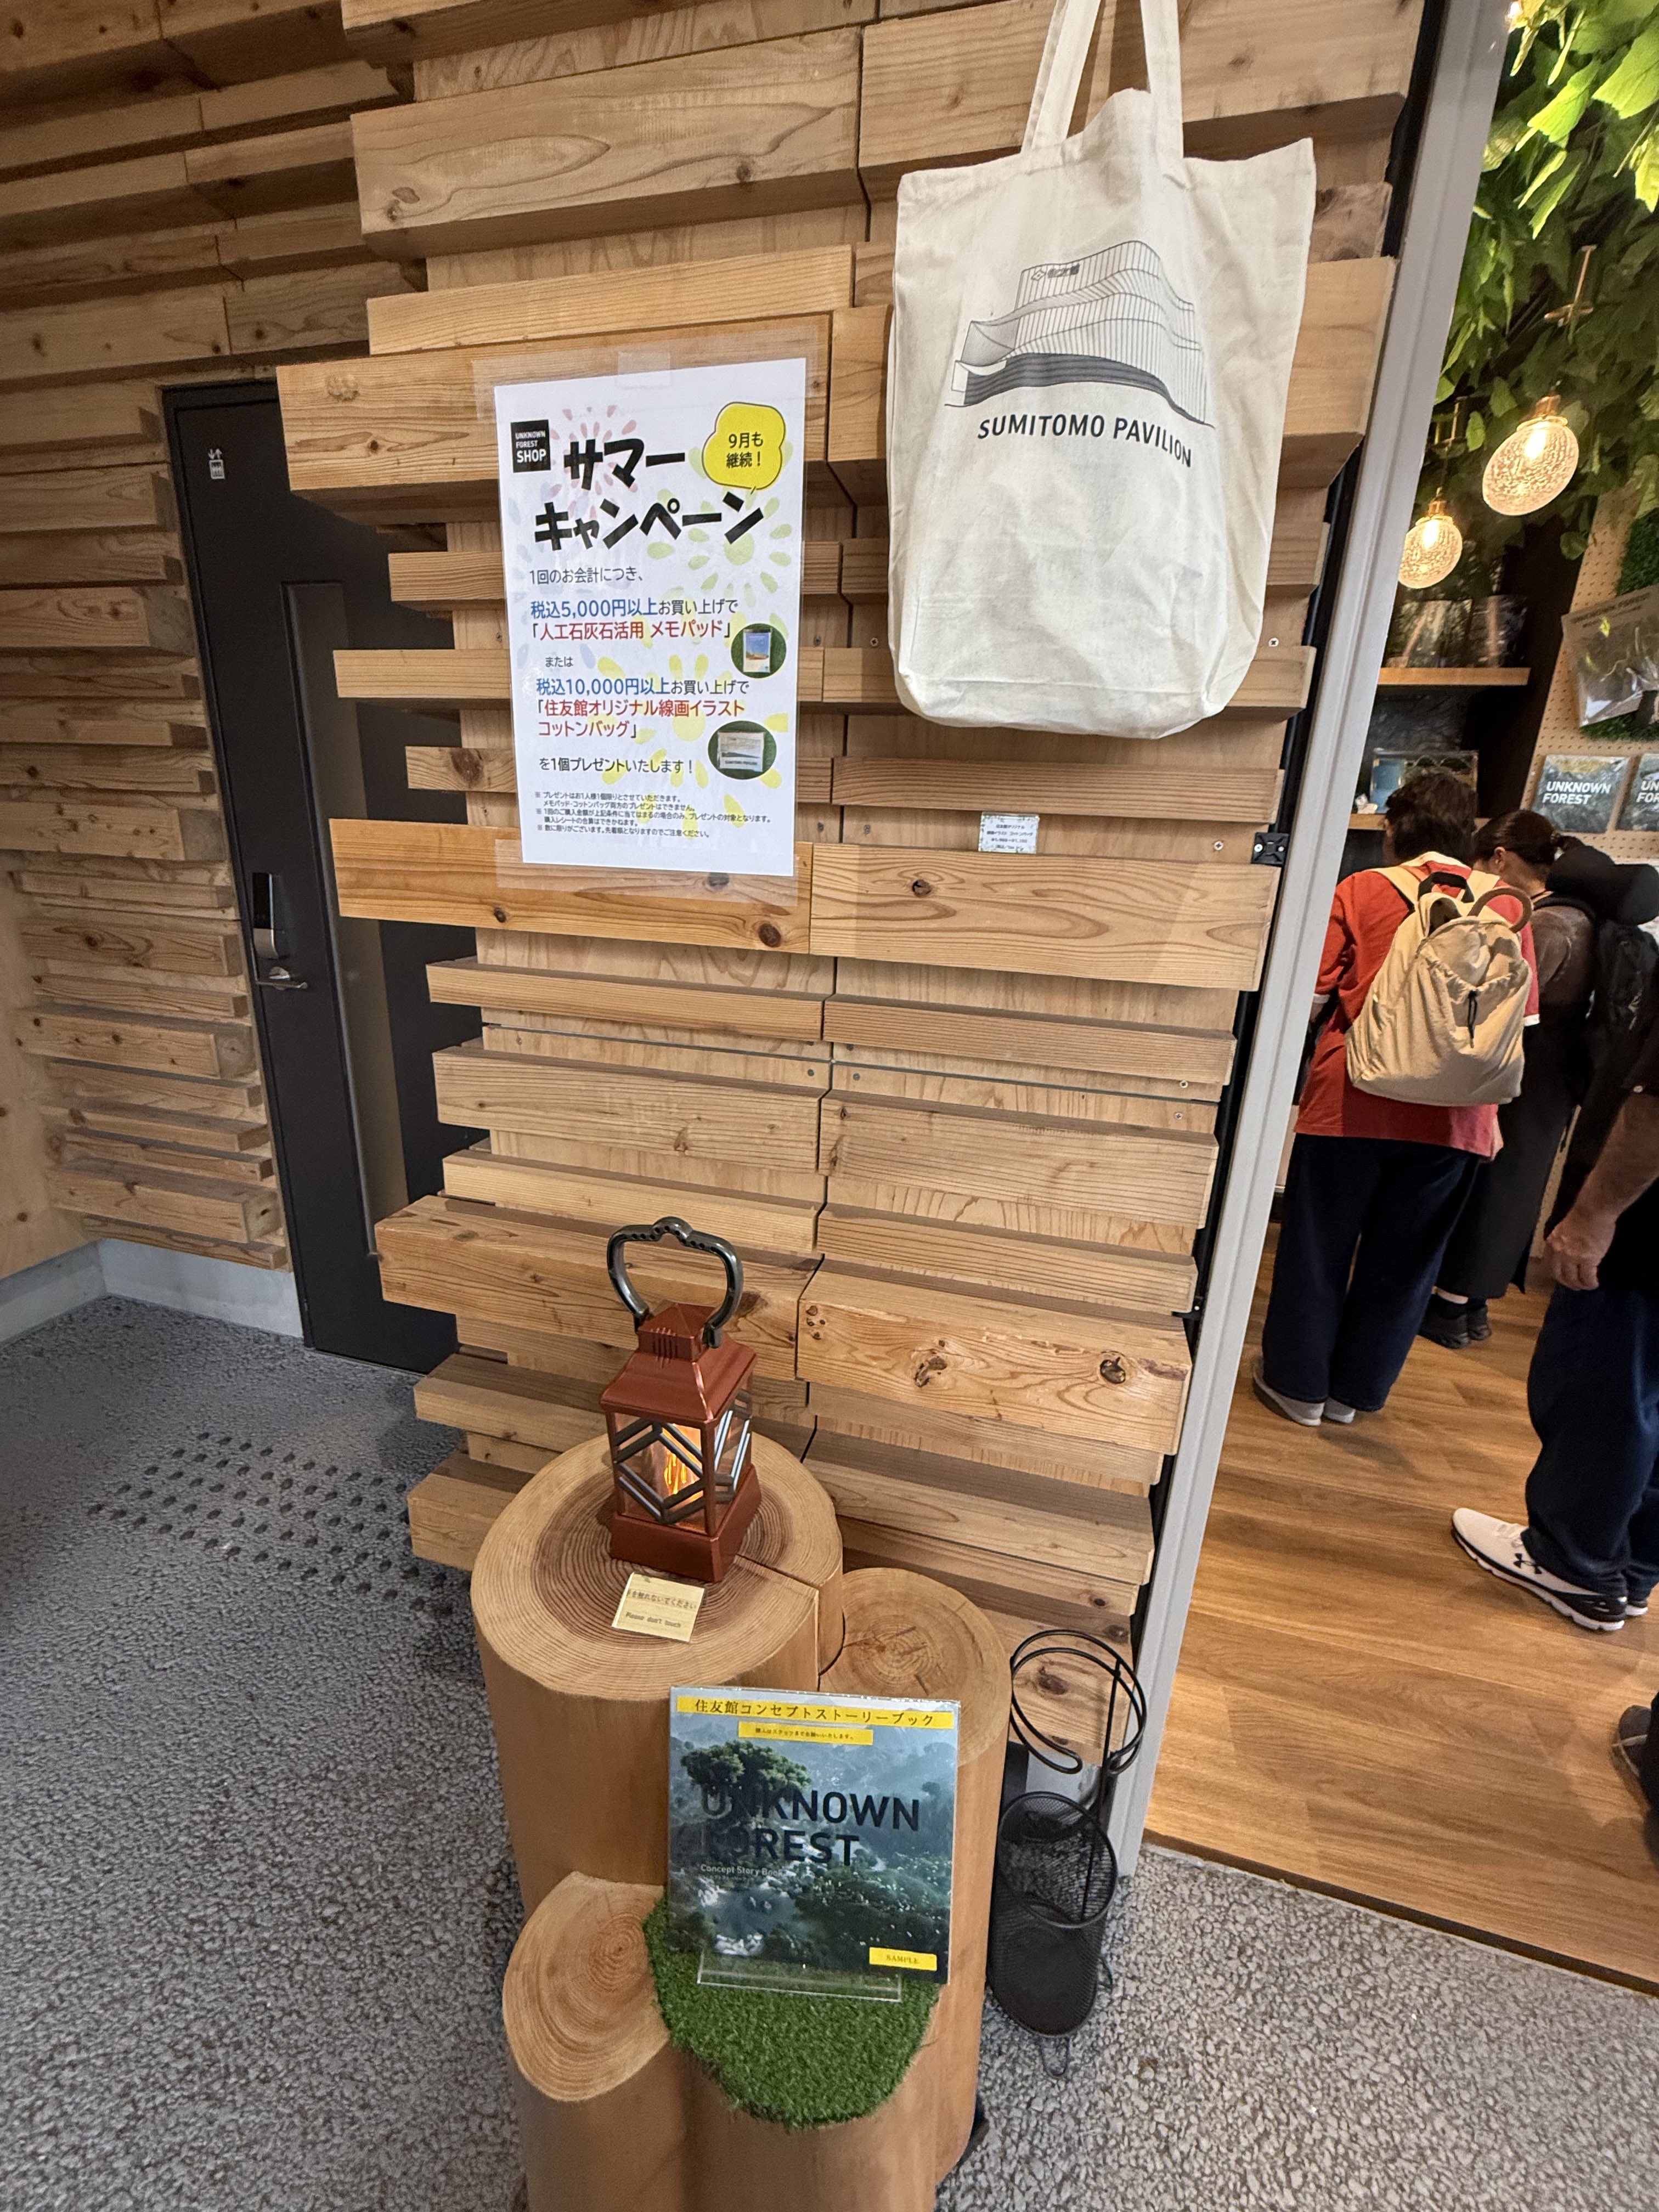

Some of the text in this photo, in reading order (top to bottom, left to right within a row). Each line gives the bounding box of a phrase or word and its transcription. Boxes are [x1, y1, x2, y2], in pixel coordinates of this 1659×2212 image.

[515, 430, 546, 440] UNKNOWN
[728, 432, 764, 449] 9月も
[977, 414, 1191, 467] SUMITOMO PAVILION
[516, 440, 538, 448] FOREST
[517, 449, 546, 463] SHOP
[564, 439, 685, 490] サマー
[726, 451, 761, 468] 継続！
[534, 492, 764, 551] キャンペーン
[529, 567, 644, 585] 1回のお会計につき、
[531, 598, 738, 618] 税込5,000円以上お買い上げで
[545, 656, 573, 667] または
[536, 678, 749, 696] 税込10,000円以上お買い上げで
[538, 699, 745, 718] 「住友館オリジナル線画イラスト
[538, 721, 637, 738] コットンバッグ」
[1546, 781, 1612, 794] UNKNOWN
[1542, 793, 1593, 805] FOREST
[695, 1699, 934, 1726] 住友館コンセプトストーリーブック
[701, 1864, 783, 1876] Concept Story Book
[886, 1955, 920, 1965] SAMPLE
